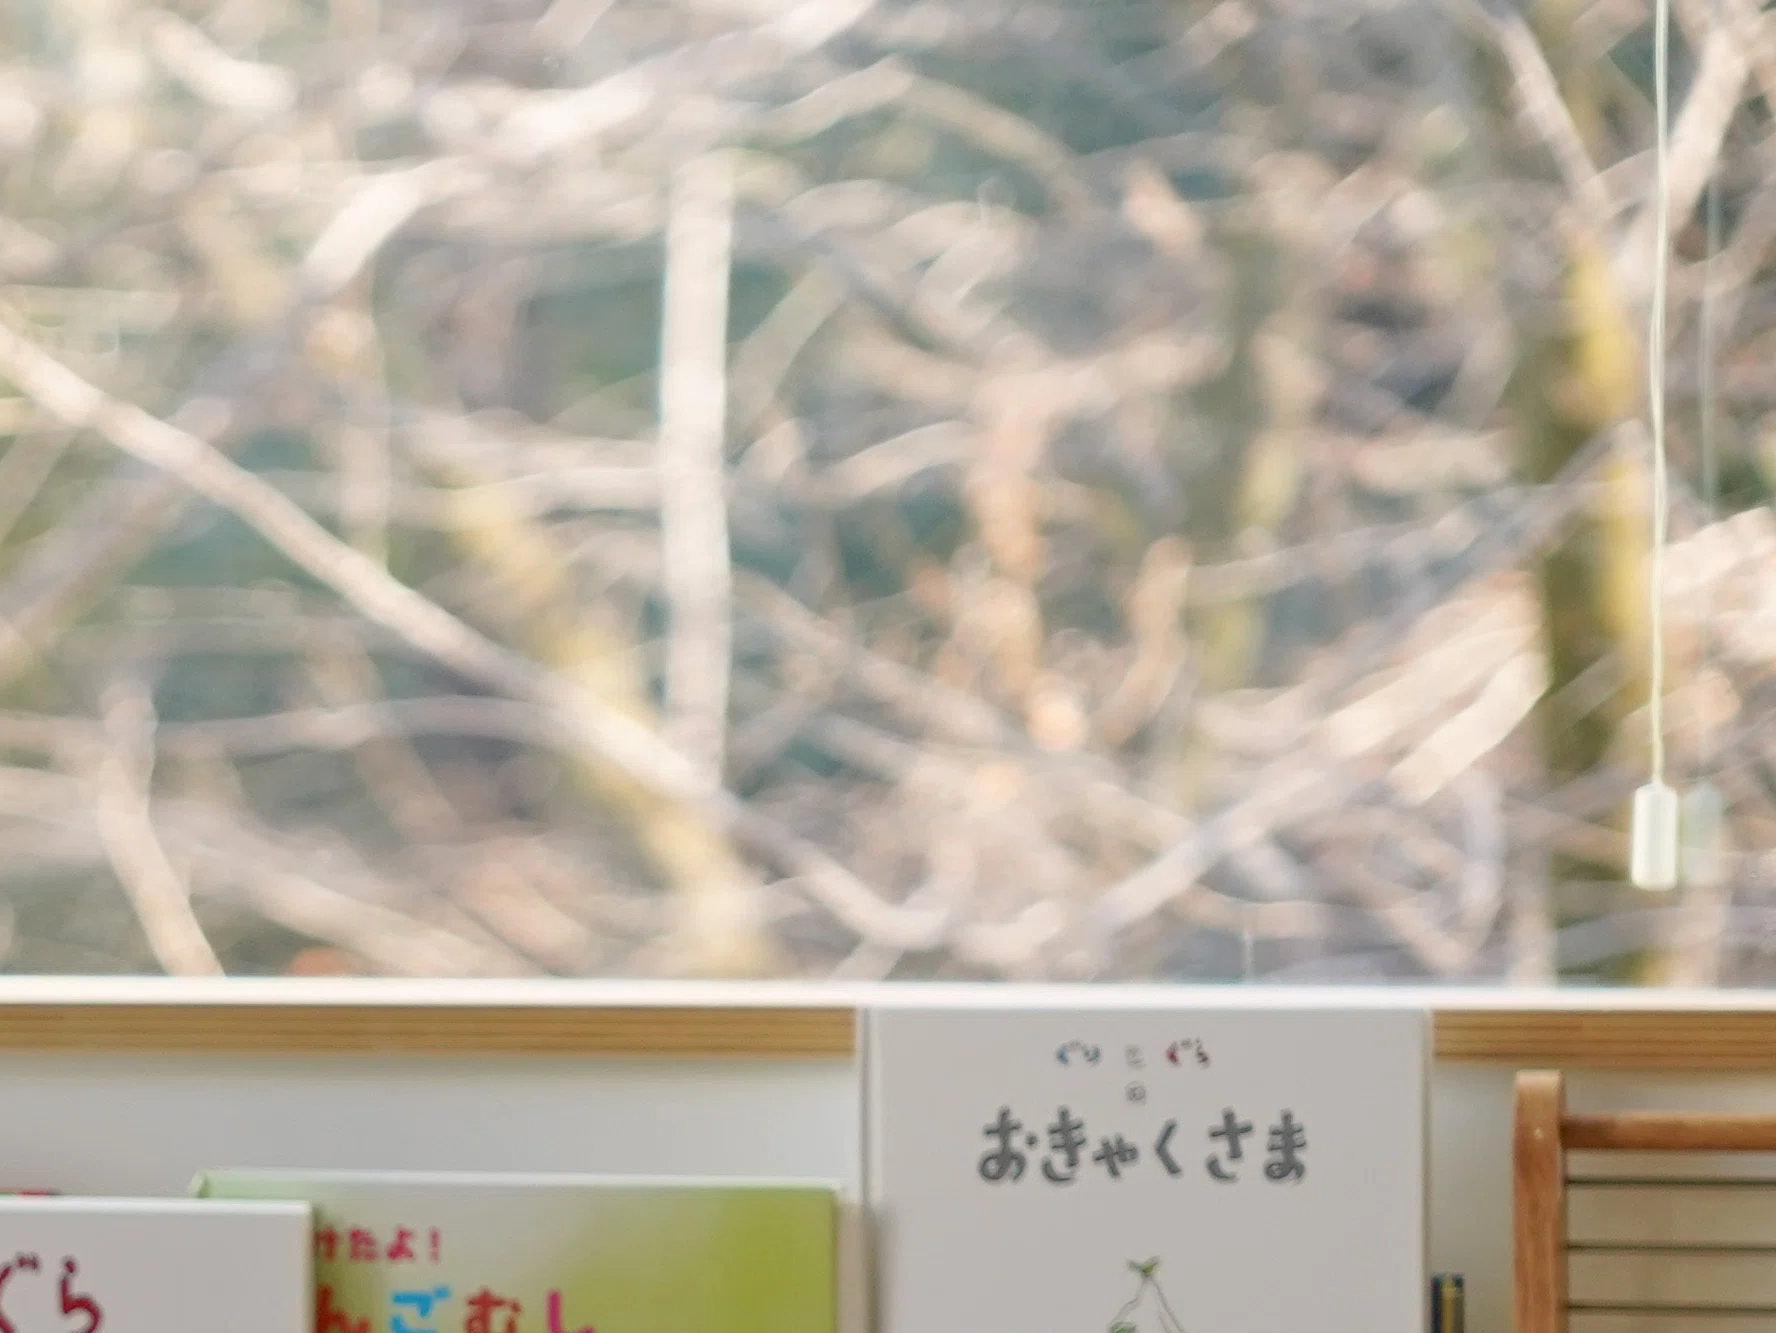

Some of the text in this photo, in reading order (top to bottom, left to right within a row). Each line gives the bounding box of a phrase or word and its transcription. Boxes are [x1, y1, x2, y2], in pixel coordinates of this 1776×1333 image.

[977, 1106, 1309, 1184] おきゃくさま
